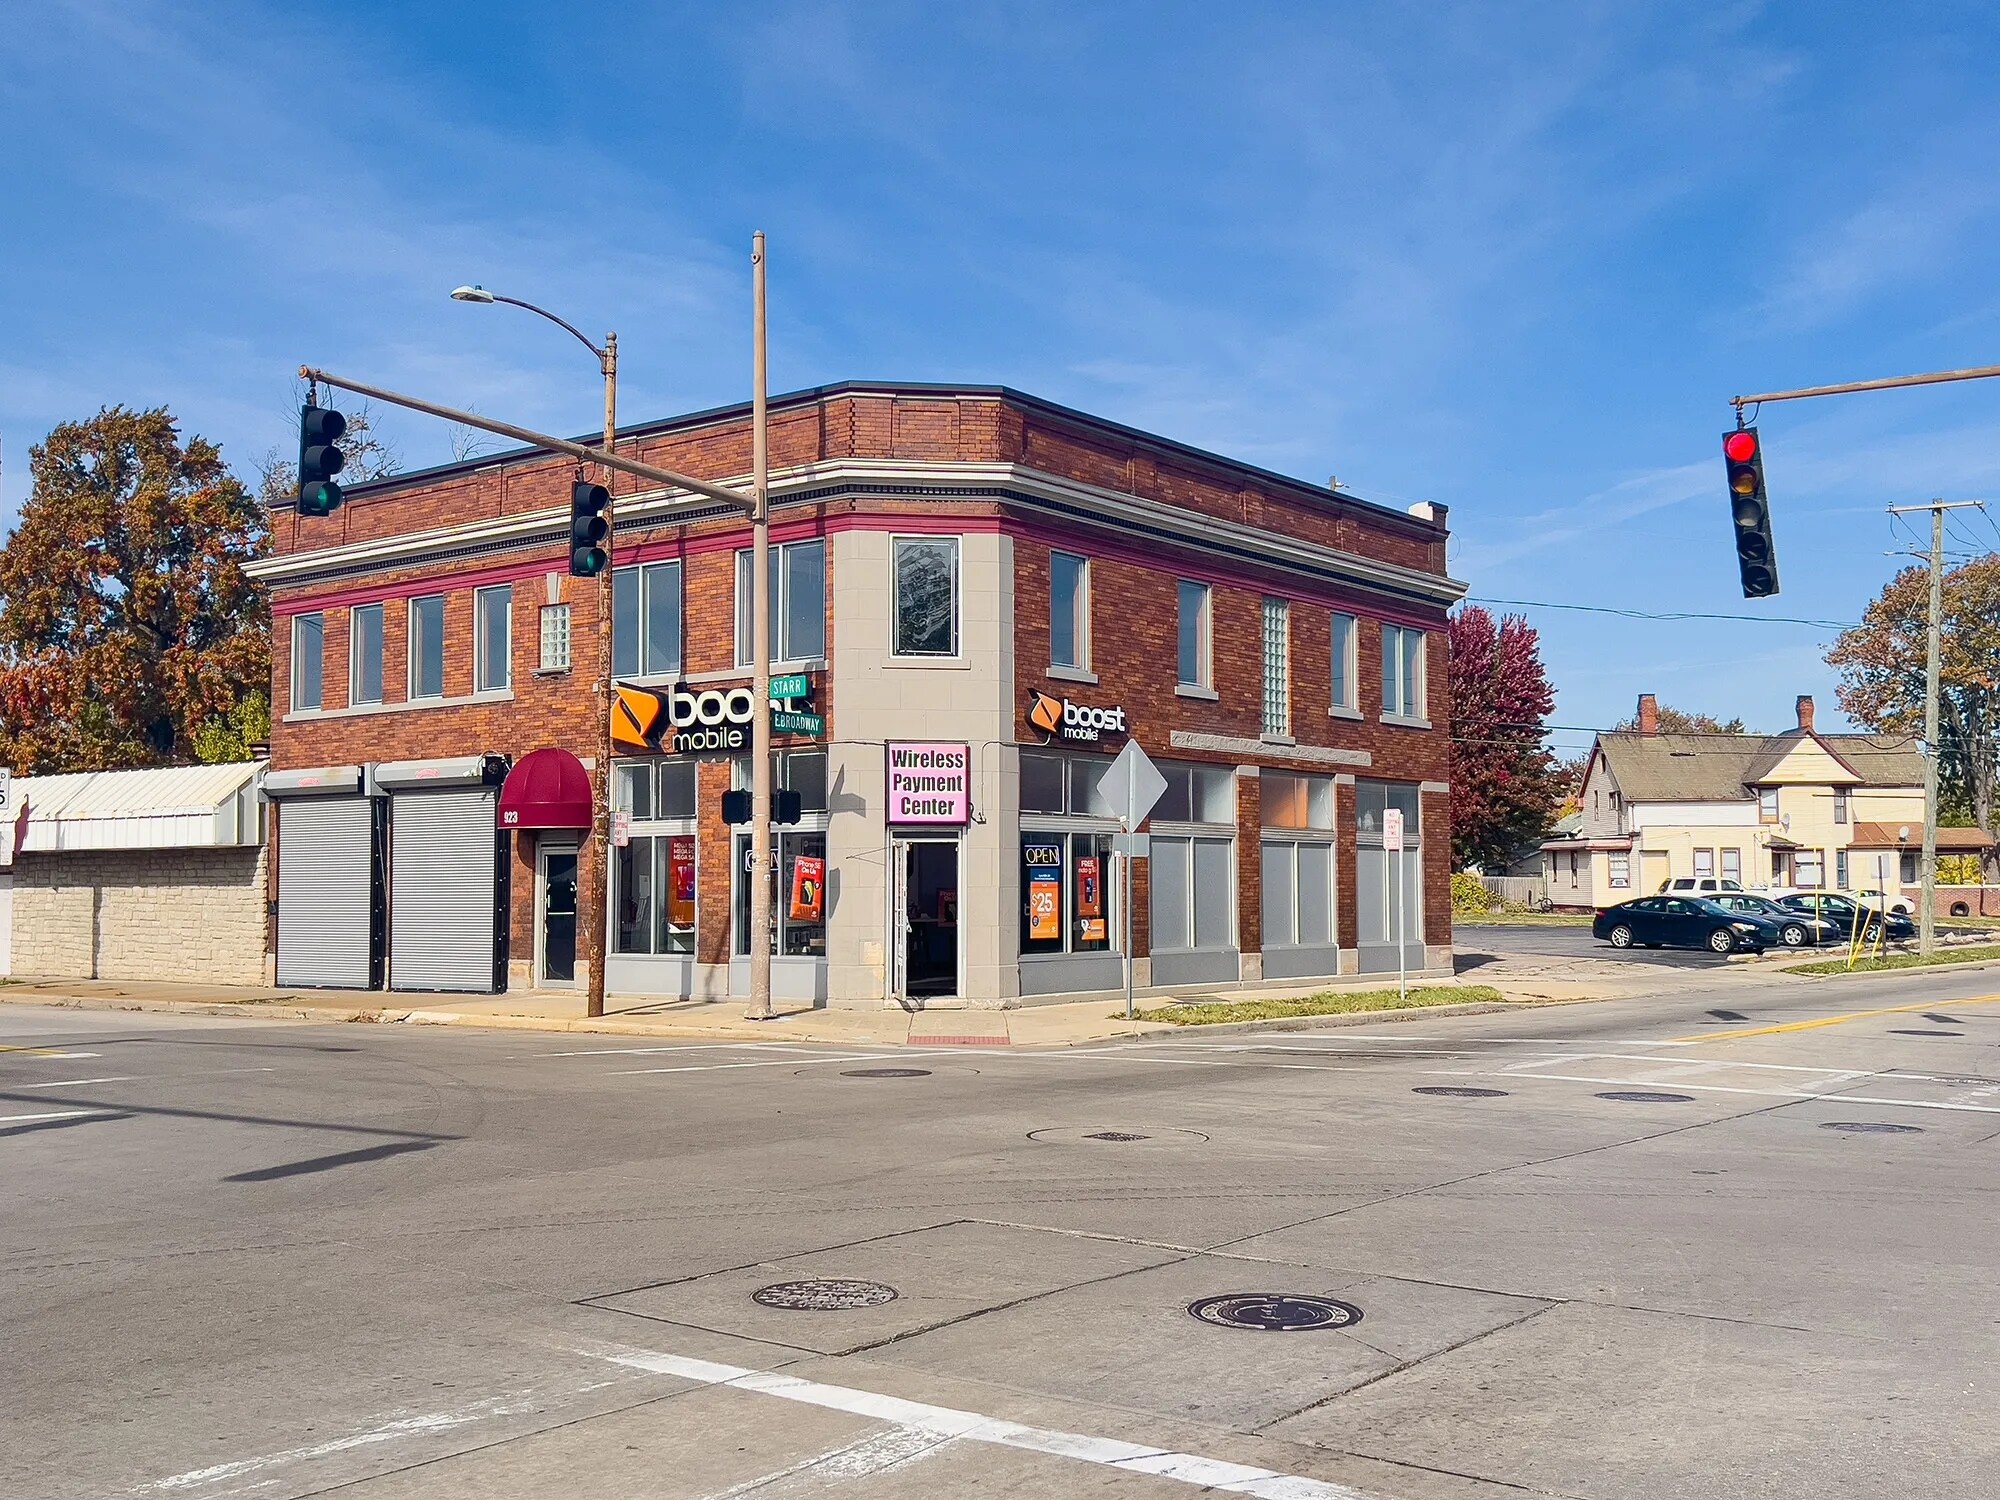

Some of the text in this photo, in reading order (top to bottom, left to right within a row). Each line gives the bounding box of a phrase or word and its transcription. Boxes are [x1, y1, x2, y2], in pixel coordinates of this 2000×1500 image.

[773, 679, 801, 695] STARR
[1063, 698, 1126, 732] boost
[672, 726, 743, 751] mobile
[1064, 727, 1099, 741] mobile
[891, 749, 964, 769] Wireless
[893, 773, 963, 794] Payment
[900, 796, 955, 815] Center
[504, 811, 518, 824] 923
[1025, 847, 1059, 864] OPEN
